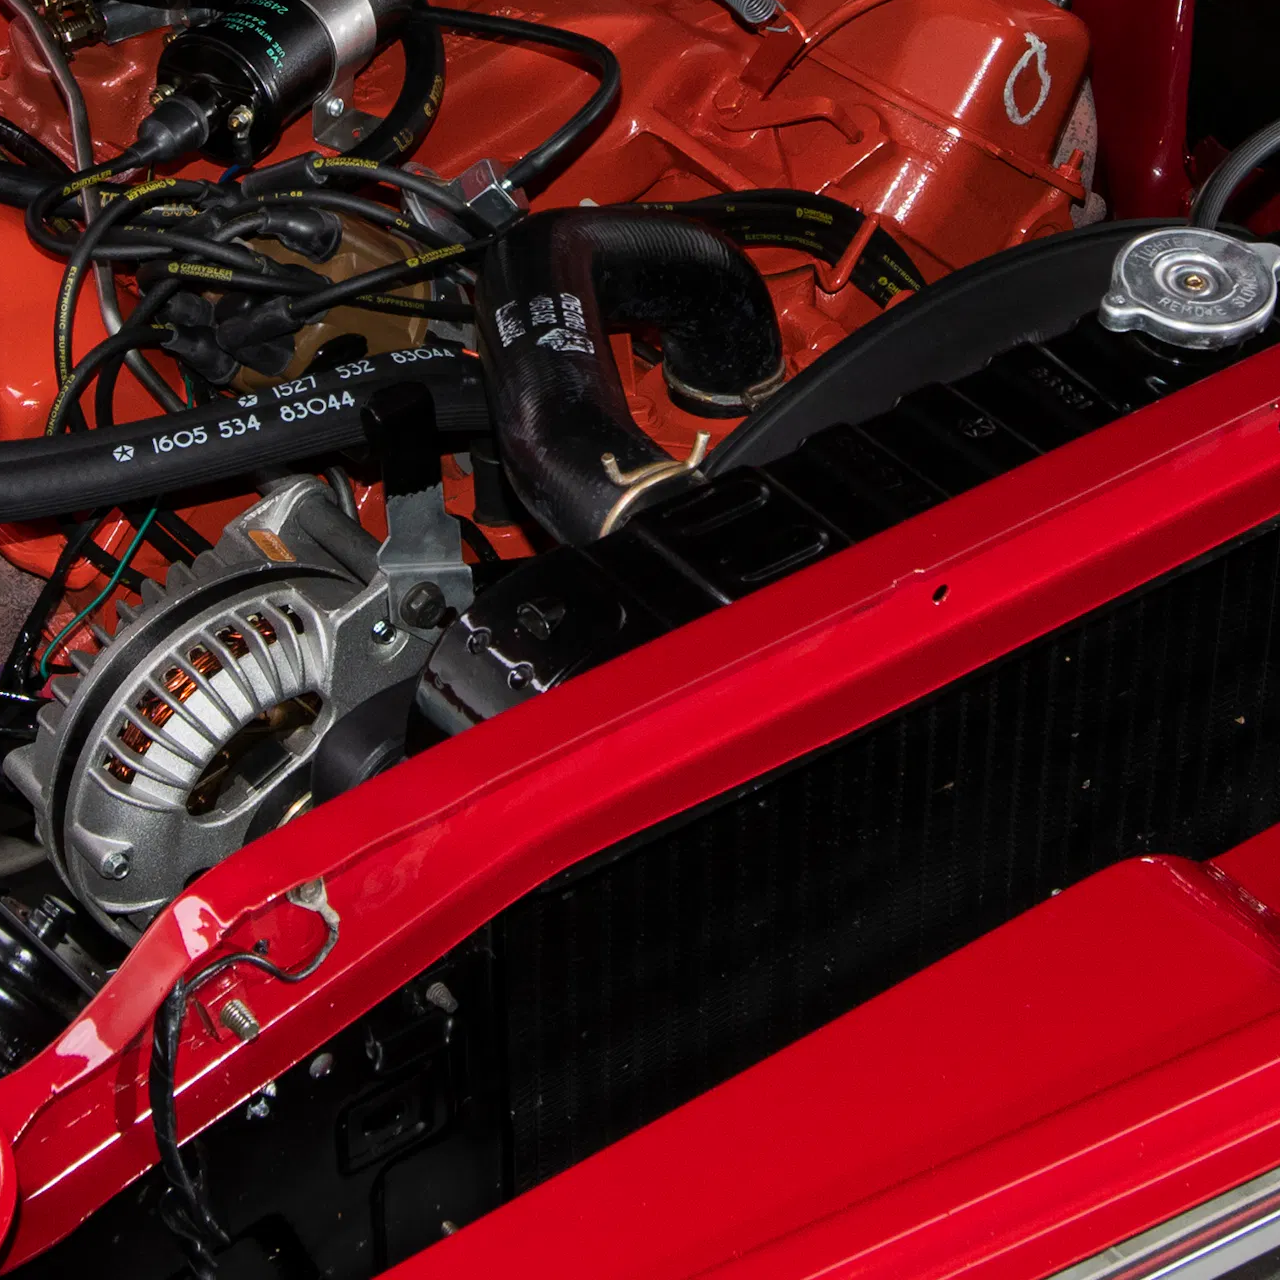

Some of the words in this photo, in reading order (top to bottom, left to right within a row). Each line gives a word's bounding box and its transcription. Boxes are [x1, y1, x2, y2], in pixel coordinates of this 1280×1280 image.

[254, 26, 273, 44] WITH
[271, 41, 286, 58] USE
[70, 169, 112, 191] CHRYSLER
[123, 180, 167, 201] CHRYSLER
[180, 263, 233, 277] CHRYSLER
[180, 269, 232, 281] CORPORATION
[883, 254, 921, 291] ELECTRONIC
[58, 266, 78, 330] ELECTRONIC
[376, 296, 424, 310] SUPPRESSION
[1157, 296, 1228, 317] REMOVE
[271, 375, 318, 400] 1527
[334, 359, 376, 380] 532
[390, 346, 456, 364] 83044
[46, 373, 76, 436] ELECTRONIC
[152, 425, 209, 455] 1605
[217, 413, 262, 439] 534
[279, 390, 356, 422] 83044
